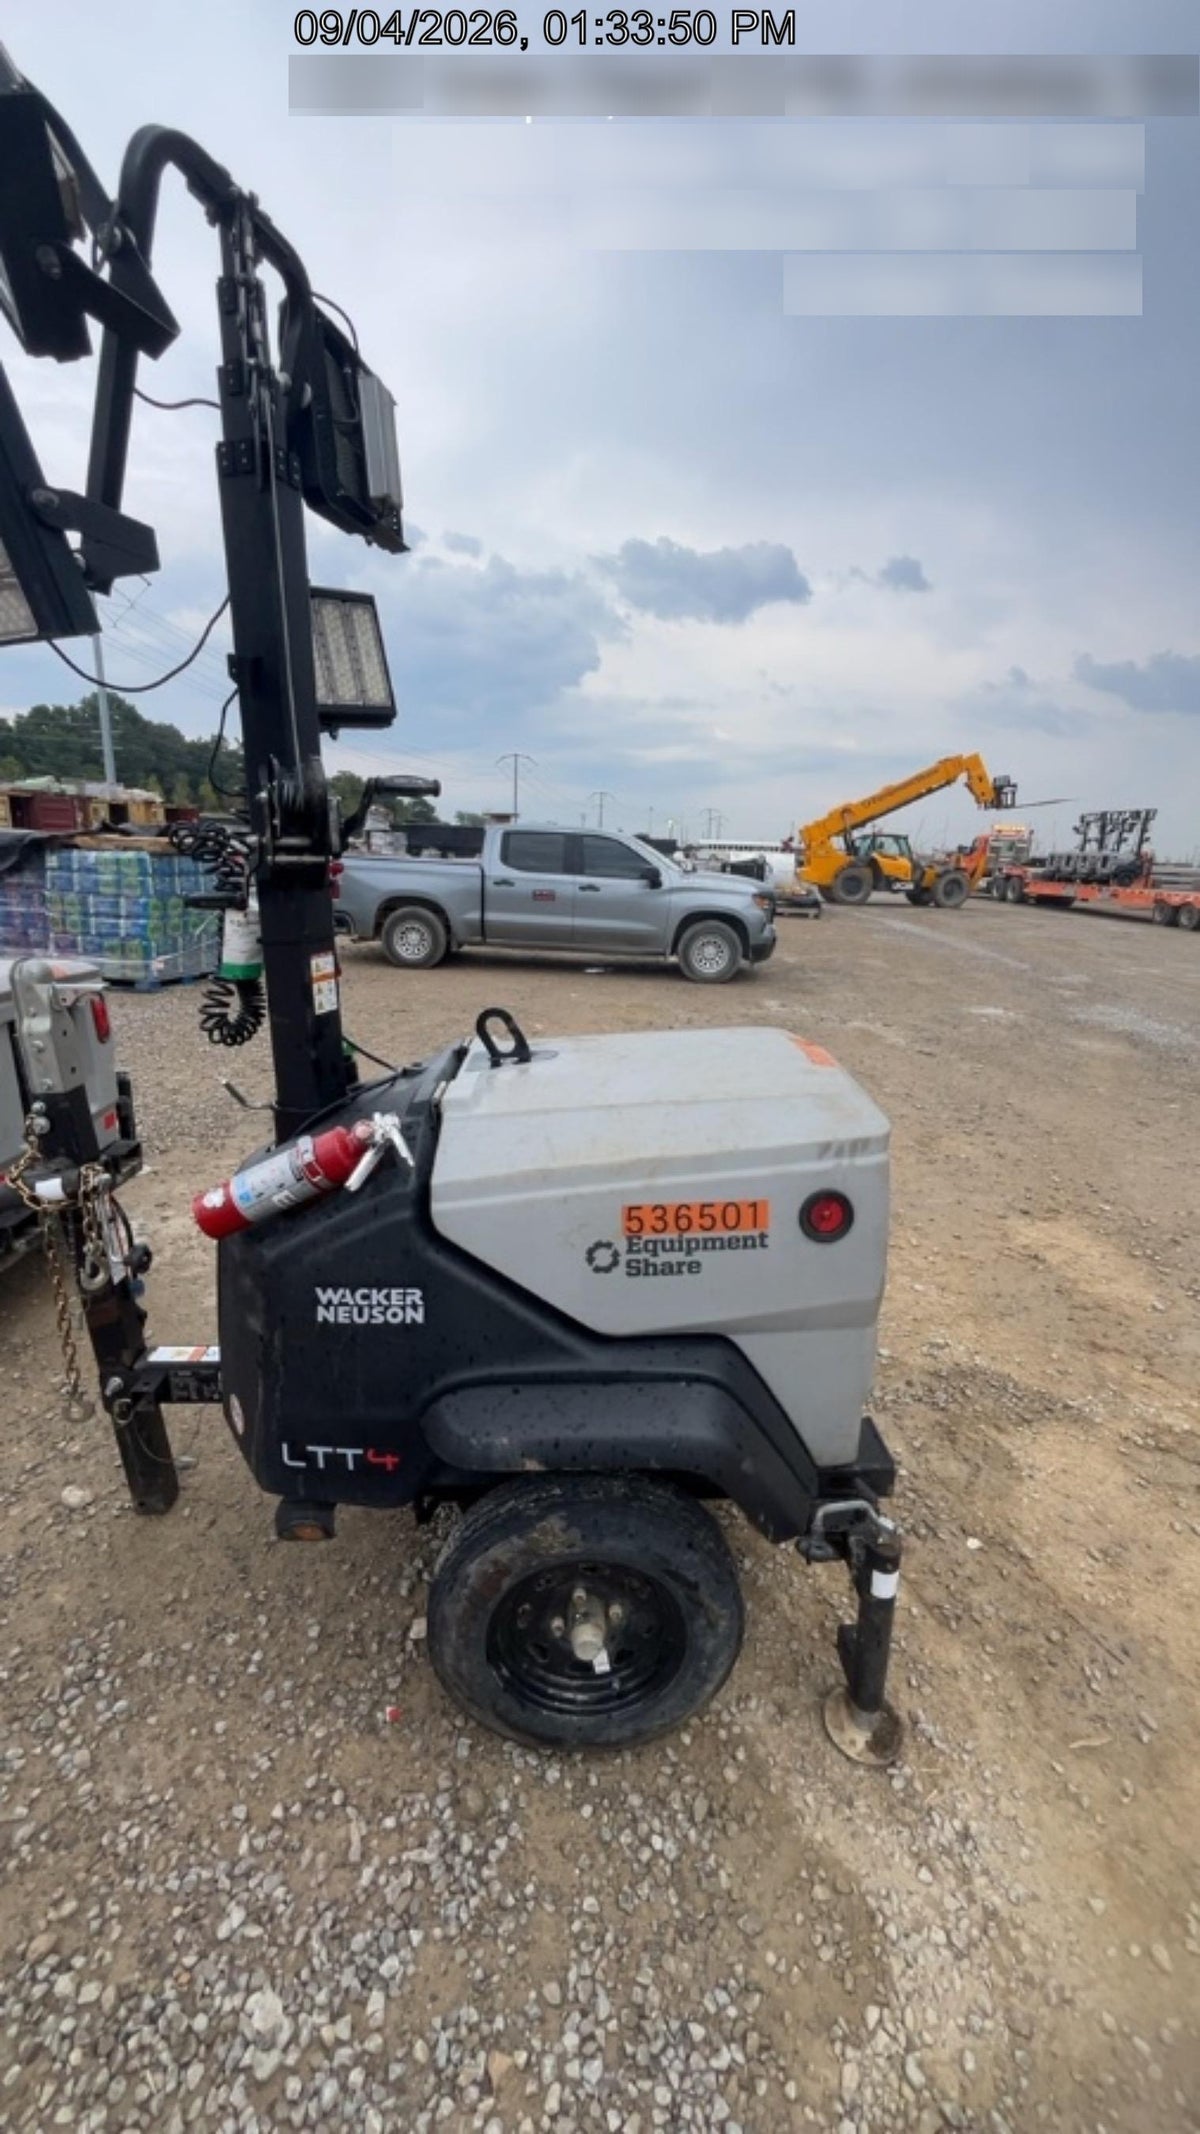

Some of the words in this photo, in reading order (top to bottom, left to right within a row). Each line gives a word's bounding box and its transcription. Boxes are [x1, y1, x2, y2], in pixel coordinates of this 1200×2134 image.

[625, 1202, 759, 1234] 536501
[626, 1232, 769, 1257] Equipment
[626, 1258, 702, 1277] Share
[315, 1287, 424, 1305] WACKER
[317, 1306, 425, 1324] NEUSON
[281, 1442, 400, 1471] LTT4
